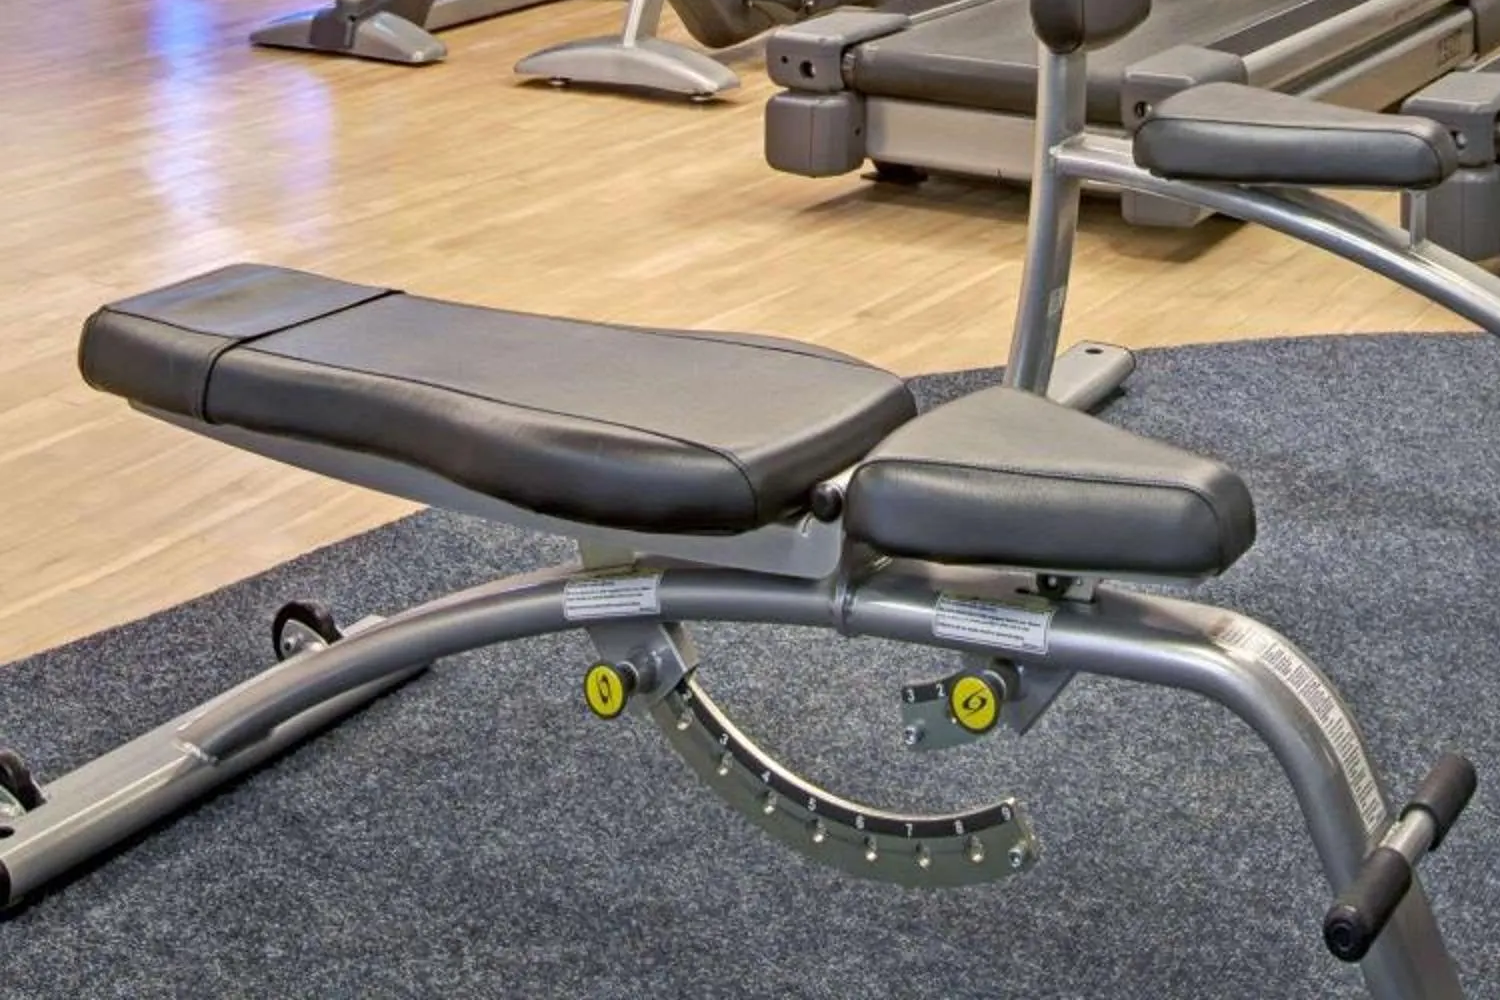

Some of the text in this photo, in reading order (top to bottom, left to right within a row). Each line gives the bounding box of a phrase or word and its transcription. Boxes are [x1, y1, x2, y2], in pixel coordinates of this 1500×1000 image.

[719, 733, 729, 746] 3
[761, 771, 771, 783] 4
[904, 823, 913, 838] 7
